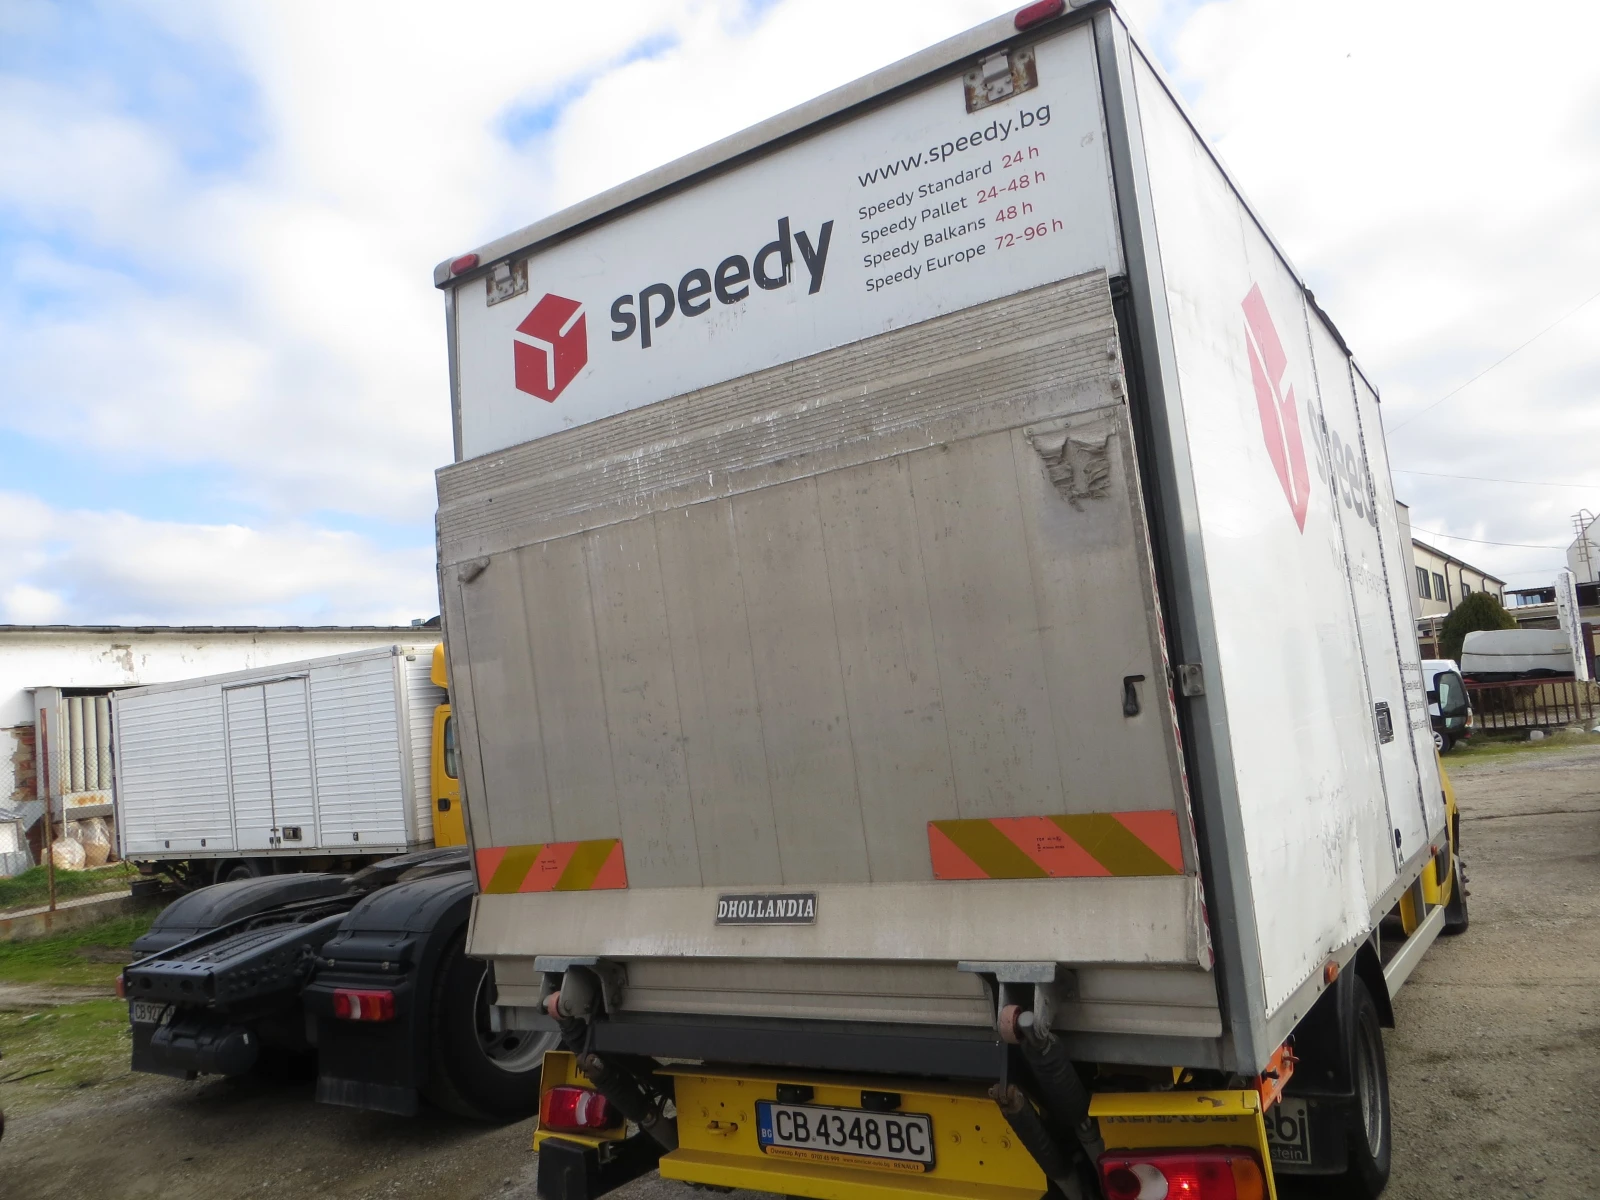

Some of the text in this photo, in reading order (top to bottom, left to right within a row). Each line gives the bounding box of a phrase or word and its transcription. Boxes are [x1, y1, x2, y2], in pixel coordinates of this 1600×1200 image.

[858, 104, 1051, 188] www.speedy.bg
[858, 145, 1040, 220] Speedy Standard 24 h
[860, 170, 1046, 244] Speedy Pallet 24-48 h
[863, 200, 1034, 269] Speedy Balkans 48 h
[610, 216, 834, 349] speedy
[865, 217, 1064, 292] Speedy Europe 72-96 h
[718, 899, 814, 918] DHOLLANDIA
[761, 1127, 773, 1139] BG
[776, 1110, 926, 1156] CB 4348 BC
